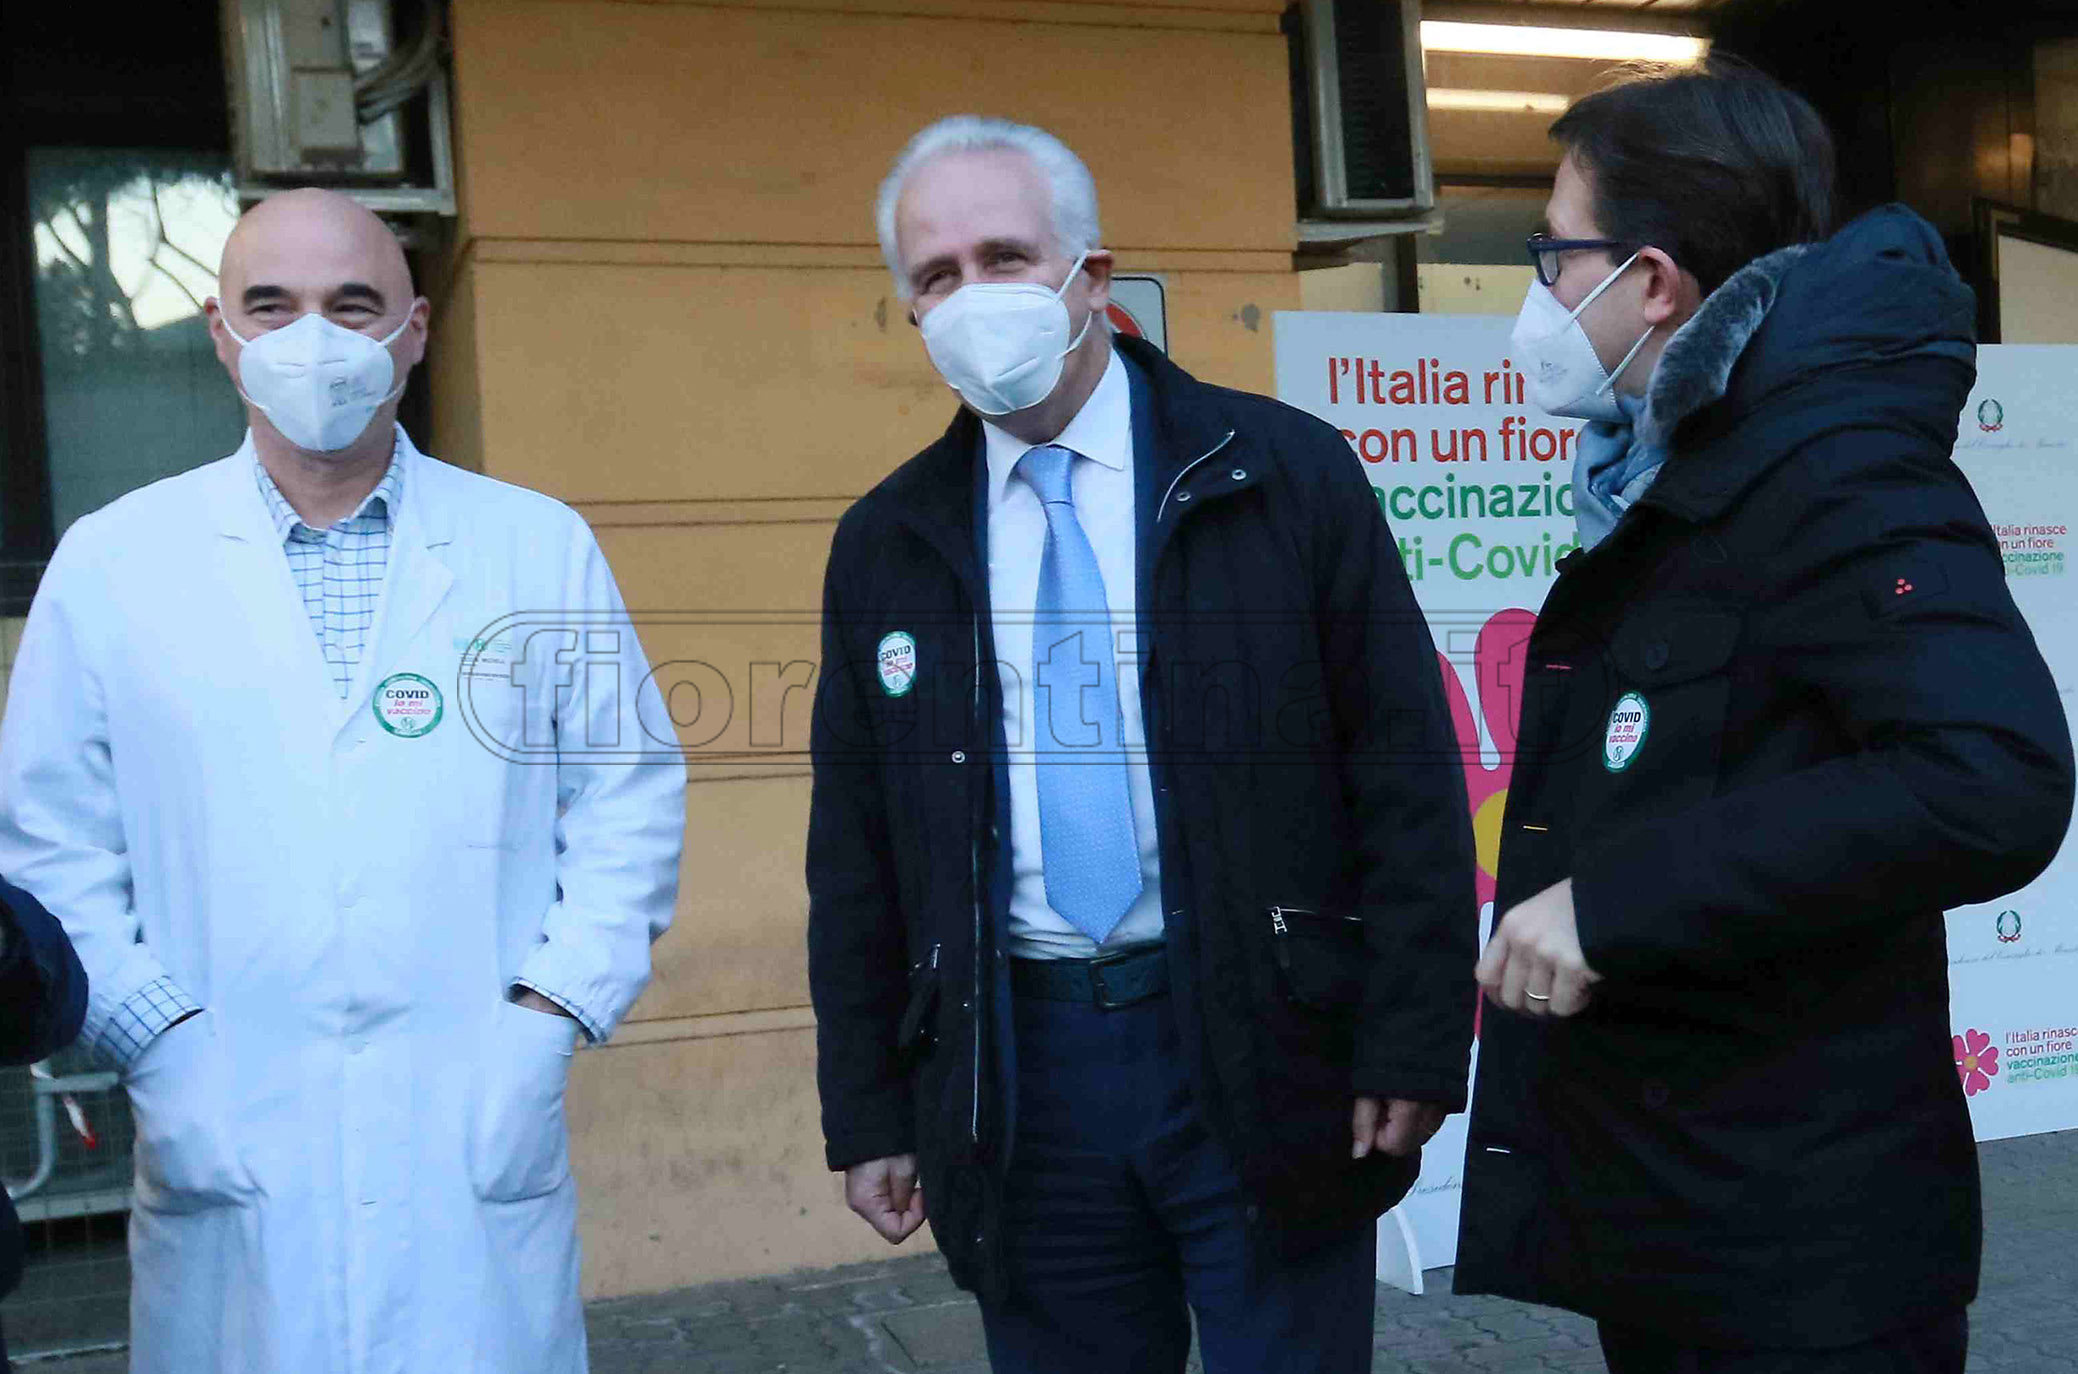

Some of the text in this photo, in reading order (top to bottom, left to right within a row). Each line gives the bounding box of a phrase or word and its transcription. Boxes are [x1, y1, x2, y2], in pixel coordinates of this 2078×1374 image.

[1328, 357, 1470, 405] l'Italia
[1430, 428, 1487, 462] un
[1498, 416, 1581, 462] fior
[2023, 523, 2067, 535] rinasce
[2011, 540, 2026, 549] un
[2029, 536, 2054, 548] fiore
[385, 689, 429, 699] COVID
[1613, 711, 1641, 723] COVID
[2006, 1040, 2073, 1058] con un fiore
